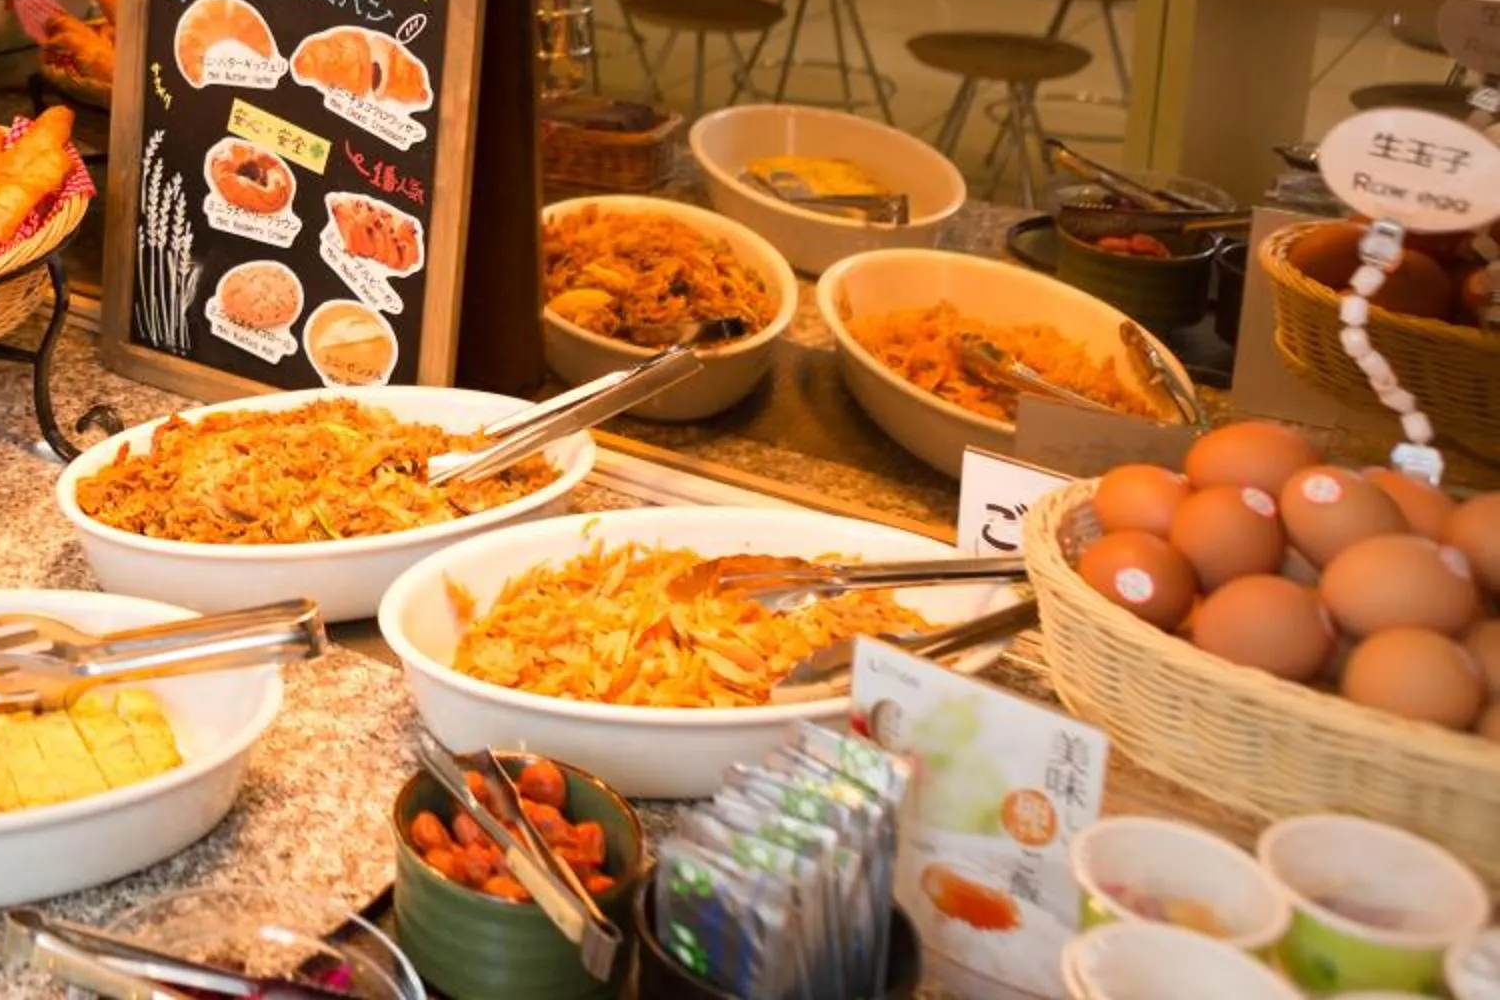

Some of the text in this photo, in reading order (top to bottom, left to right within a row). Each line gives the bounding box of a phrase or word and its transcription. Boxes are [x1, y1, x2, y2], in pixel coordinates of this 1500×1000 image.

[1369, 131, 1472, 175] 生玉子
[1352, 172, 1471, 215] Raw egg
